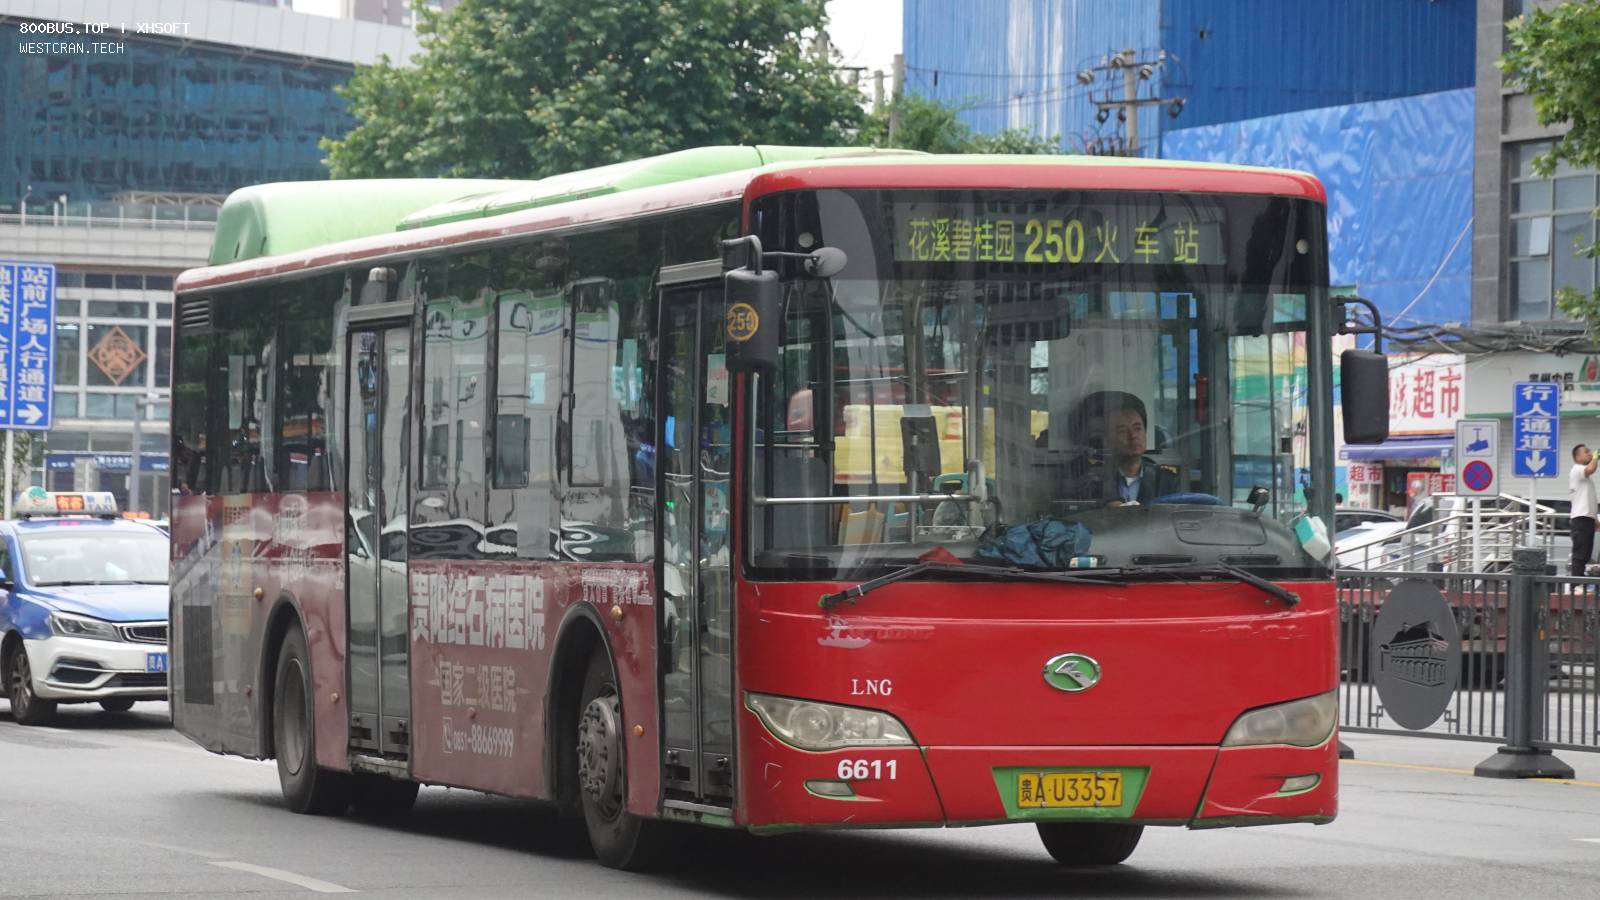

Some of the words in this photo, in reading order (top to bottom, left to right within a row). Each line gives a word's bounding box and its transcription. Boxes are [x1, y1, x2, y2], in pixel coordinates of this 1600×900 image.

[908, 217, 1014, 262] 花溪碧桂园
[1024, 219, 1084, 263] 250
[1094, 221, 1199, 264] 火车站
[18, 267, 49, 402] 站前广场人行通道
[727, 311, 754, 331] 250
[1521, 385, 1553, 450] 行人通道
[1349, 464, 1382, 482] 超市
[411, 573, 545, 651] 贵阳结石病医院
[851, 679, 893, 696] LNG
[837, 759, 897, 780] 6611
